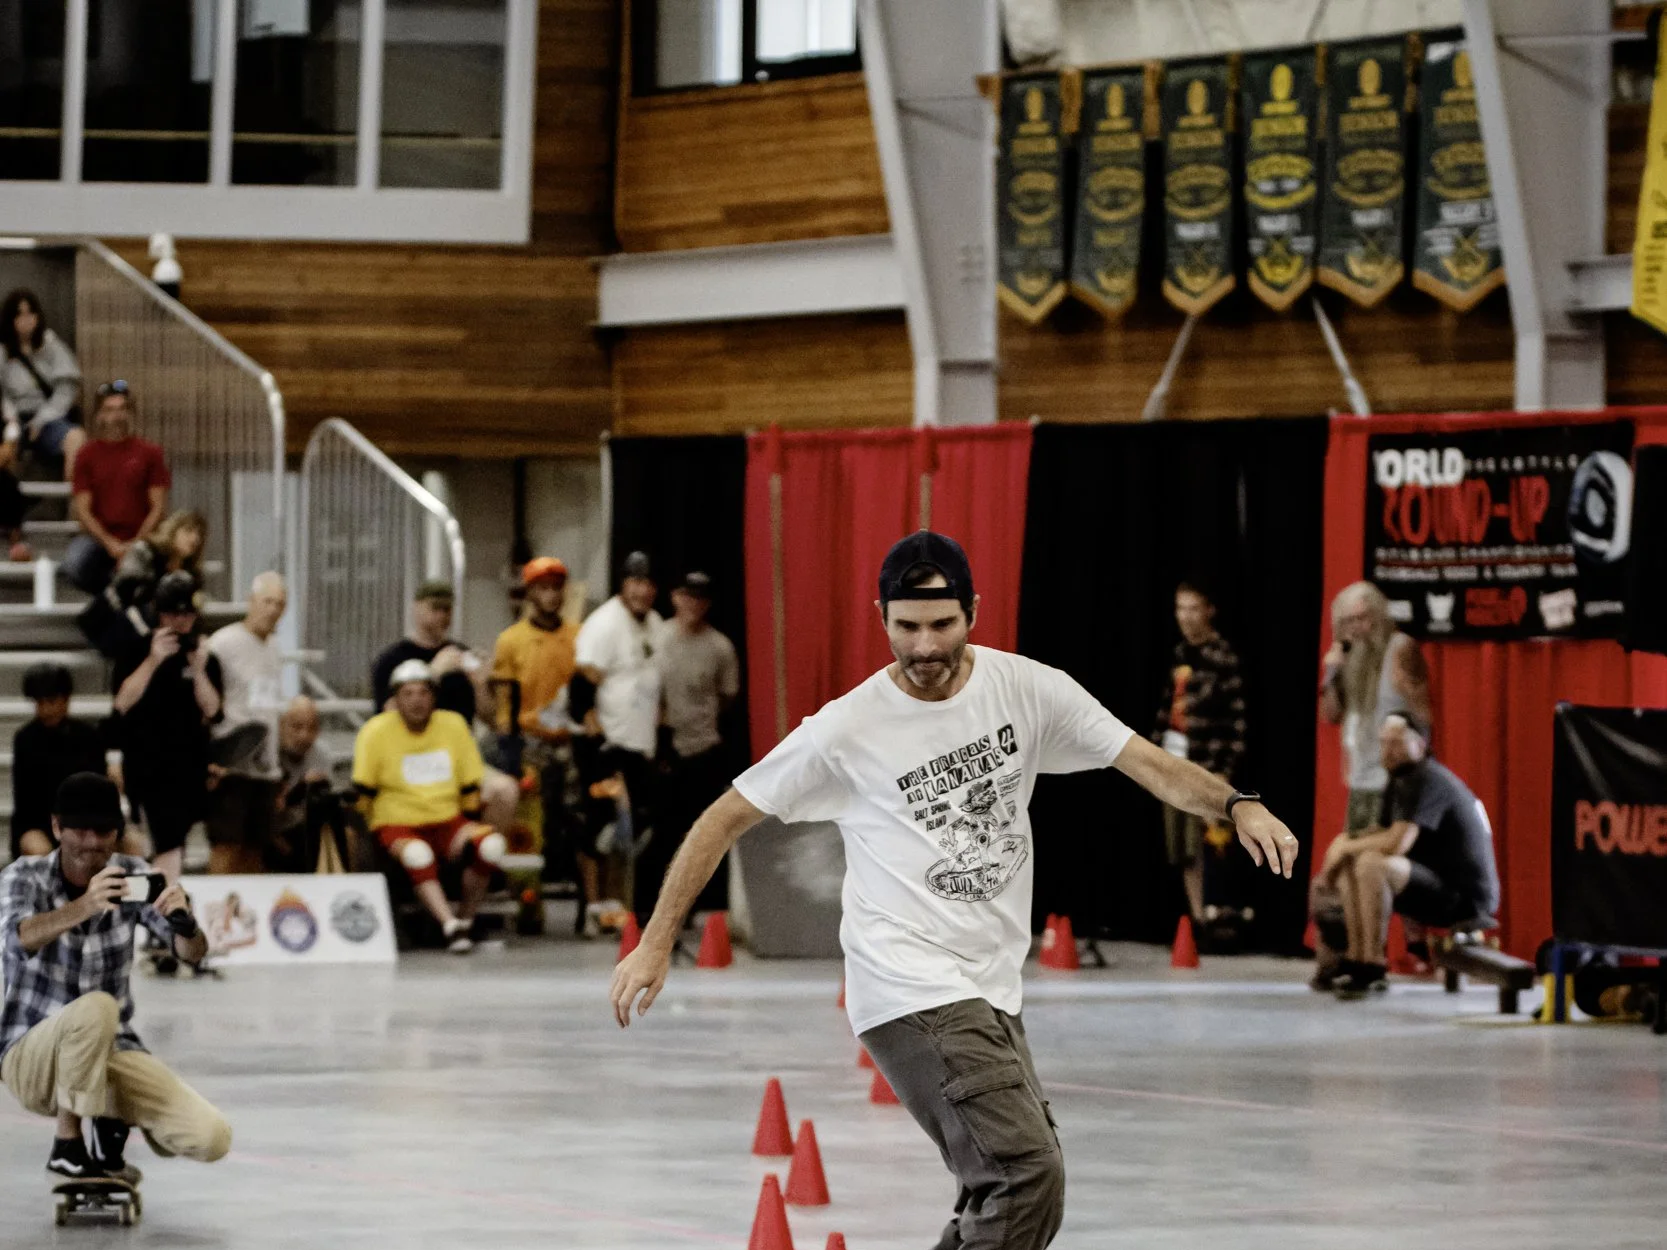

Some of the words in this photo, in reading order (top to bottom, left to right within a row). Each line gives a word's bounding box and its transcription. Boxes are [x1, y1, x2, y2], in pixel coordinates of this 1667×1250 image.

[1374, 447, 1465, 488] ORLD
[896, 766, 929, 791] THE
[923, 746, 1004, 802] KANAKAS
[998, 724, 1018, 755] 4
